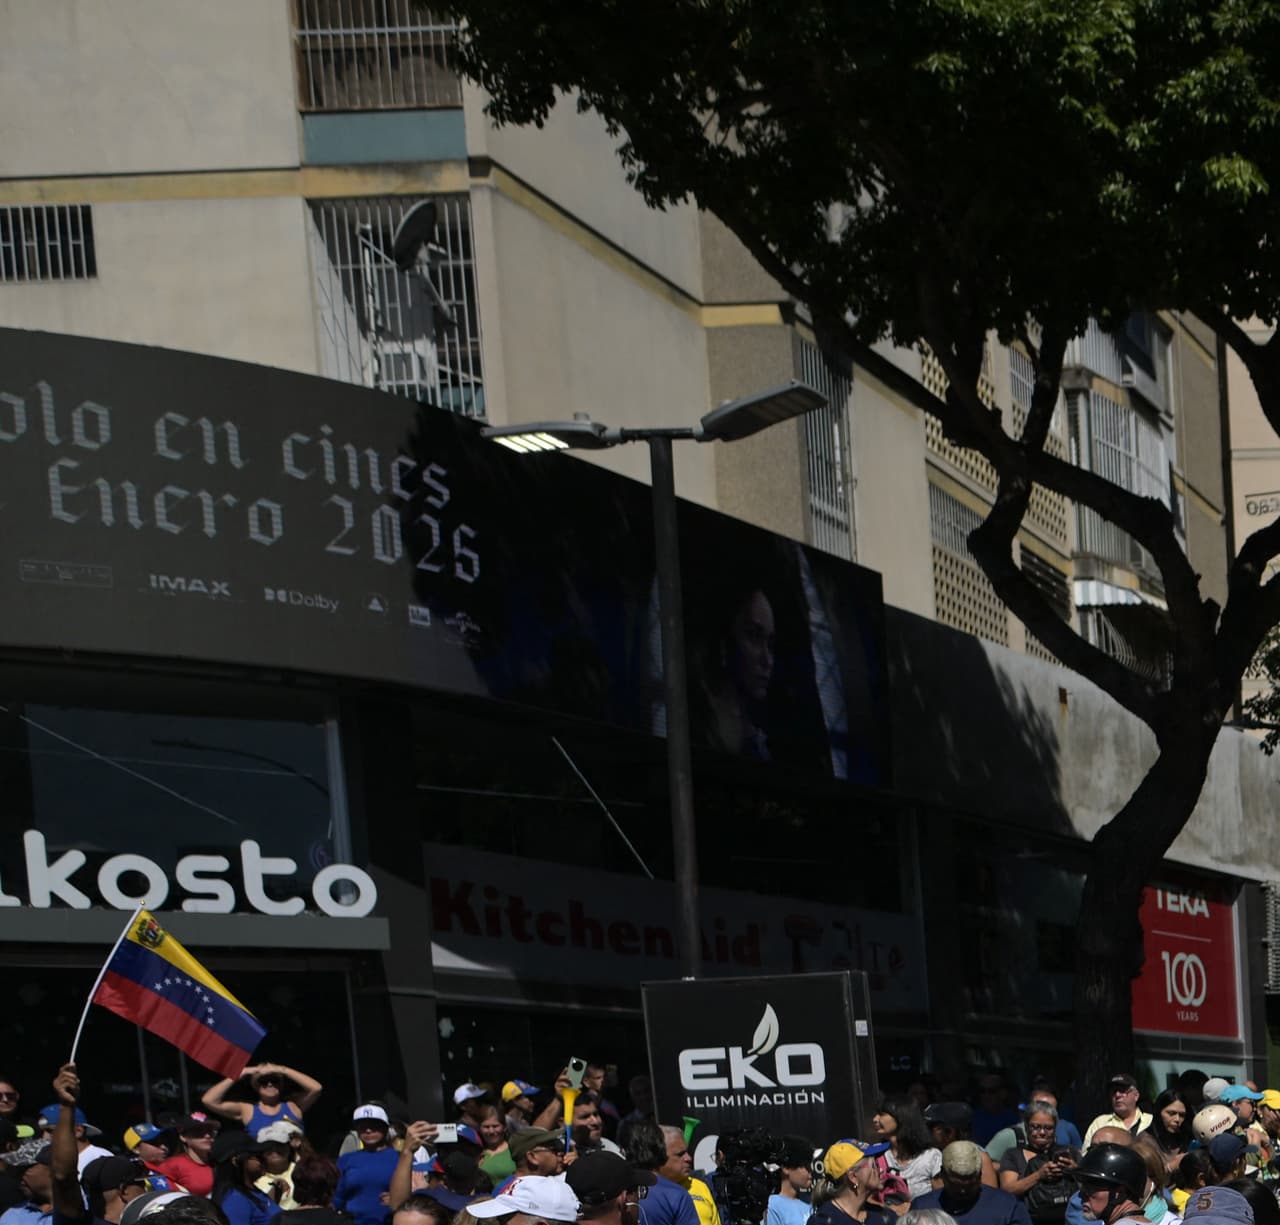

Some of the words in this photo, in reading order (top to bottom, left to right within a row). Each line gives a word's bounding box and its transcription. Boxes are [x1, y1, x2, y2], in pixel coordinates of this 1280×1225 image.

[154, 411, 248, 470] en
[281, 424, 451, 510] cines
[48, 456, 284, 546] Enero
[323, 492, 480, 584] 2026
[150, 572, 232, 597] IMAX
[288, 591, 340, 613] Dolby
[0, 828, 378, 918] kosto
[1161, 950, 1208, 1007] 100
[1177, 1011, 1200, 1023] YEARS
[678, 1042, 826, 1091] EKO
[686, 1089, 826, 1108] ILUMINACIÓN
[1210, 1116, 1231, 1133] VIGOR
